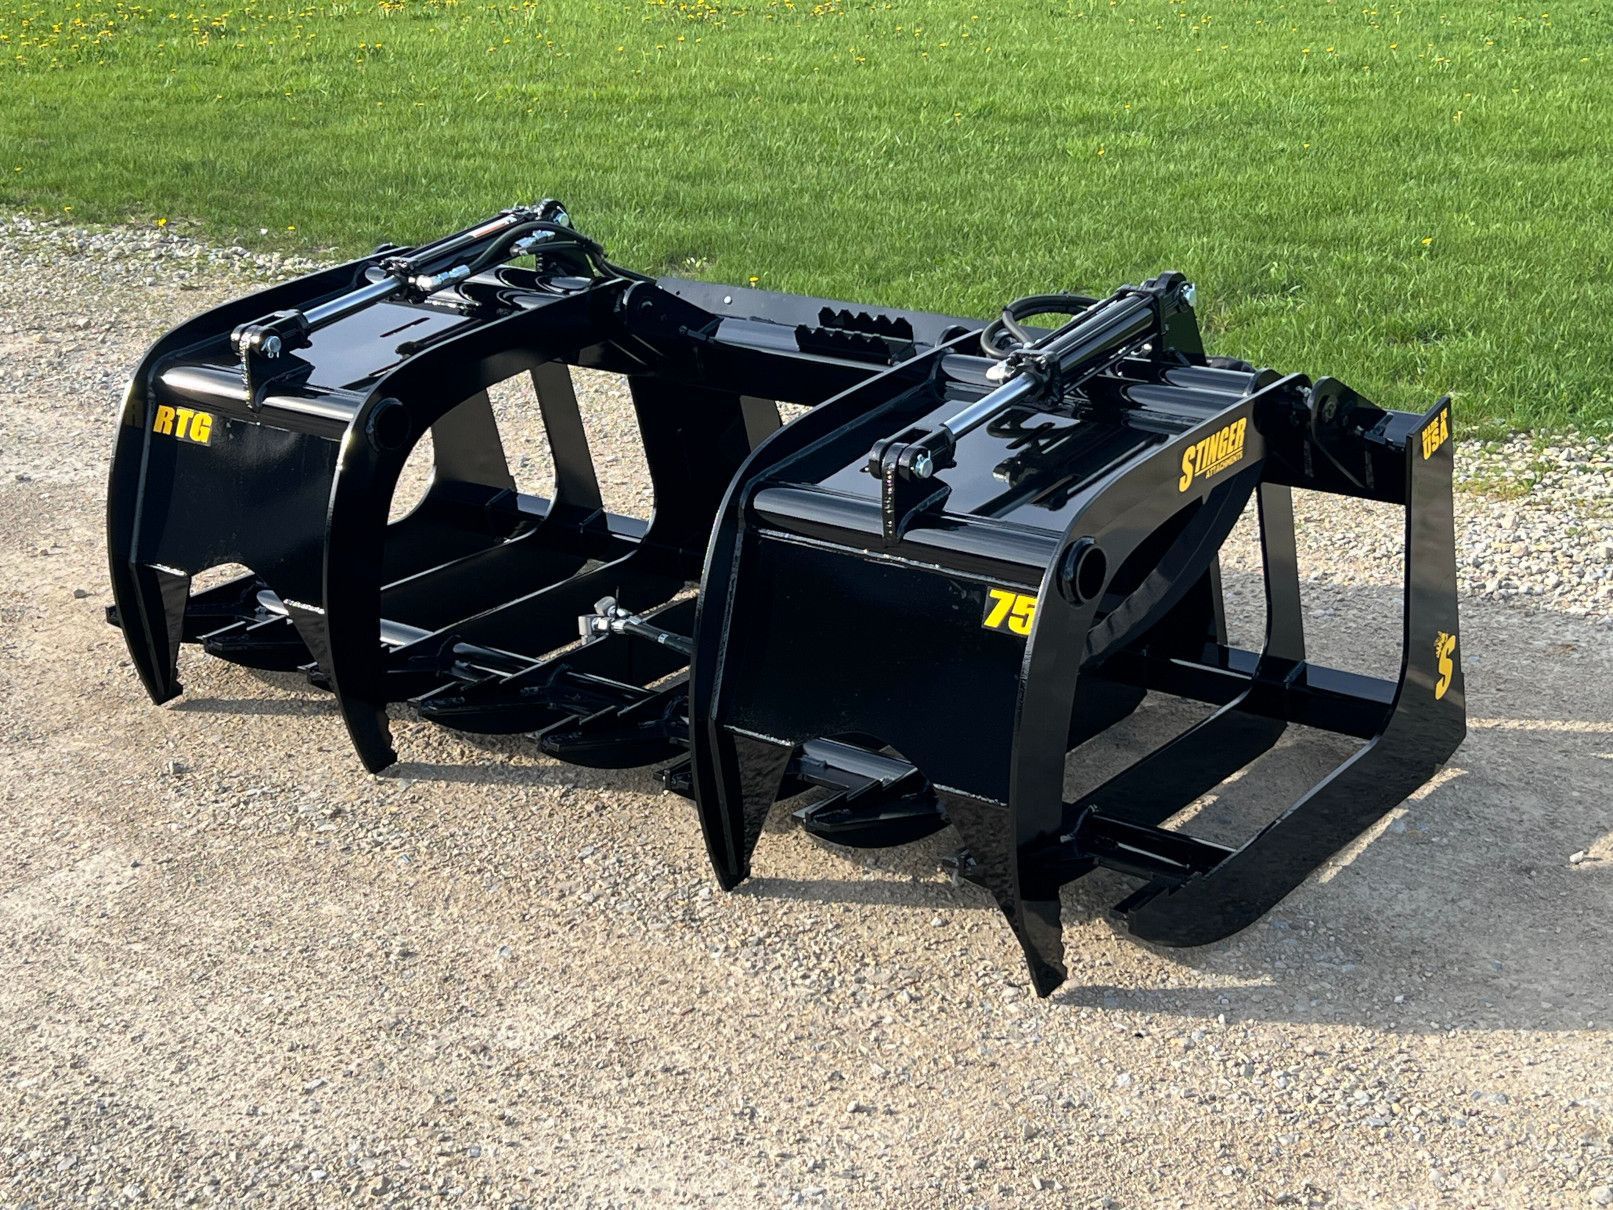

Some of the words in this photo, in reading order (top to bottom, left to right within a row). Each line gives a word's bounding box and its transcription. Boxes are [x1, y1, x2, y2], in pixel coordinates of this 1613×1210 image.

[153, 404, 213, 444] RTG
[1422, 416, 1449, 460] USA
[1178, 417, 1247, 492] STINGER
[983, 588, 1038, 636] 75
